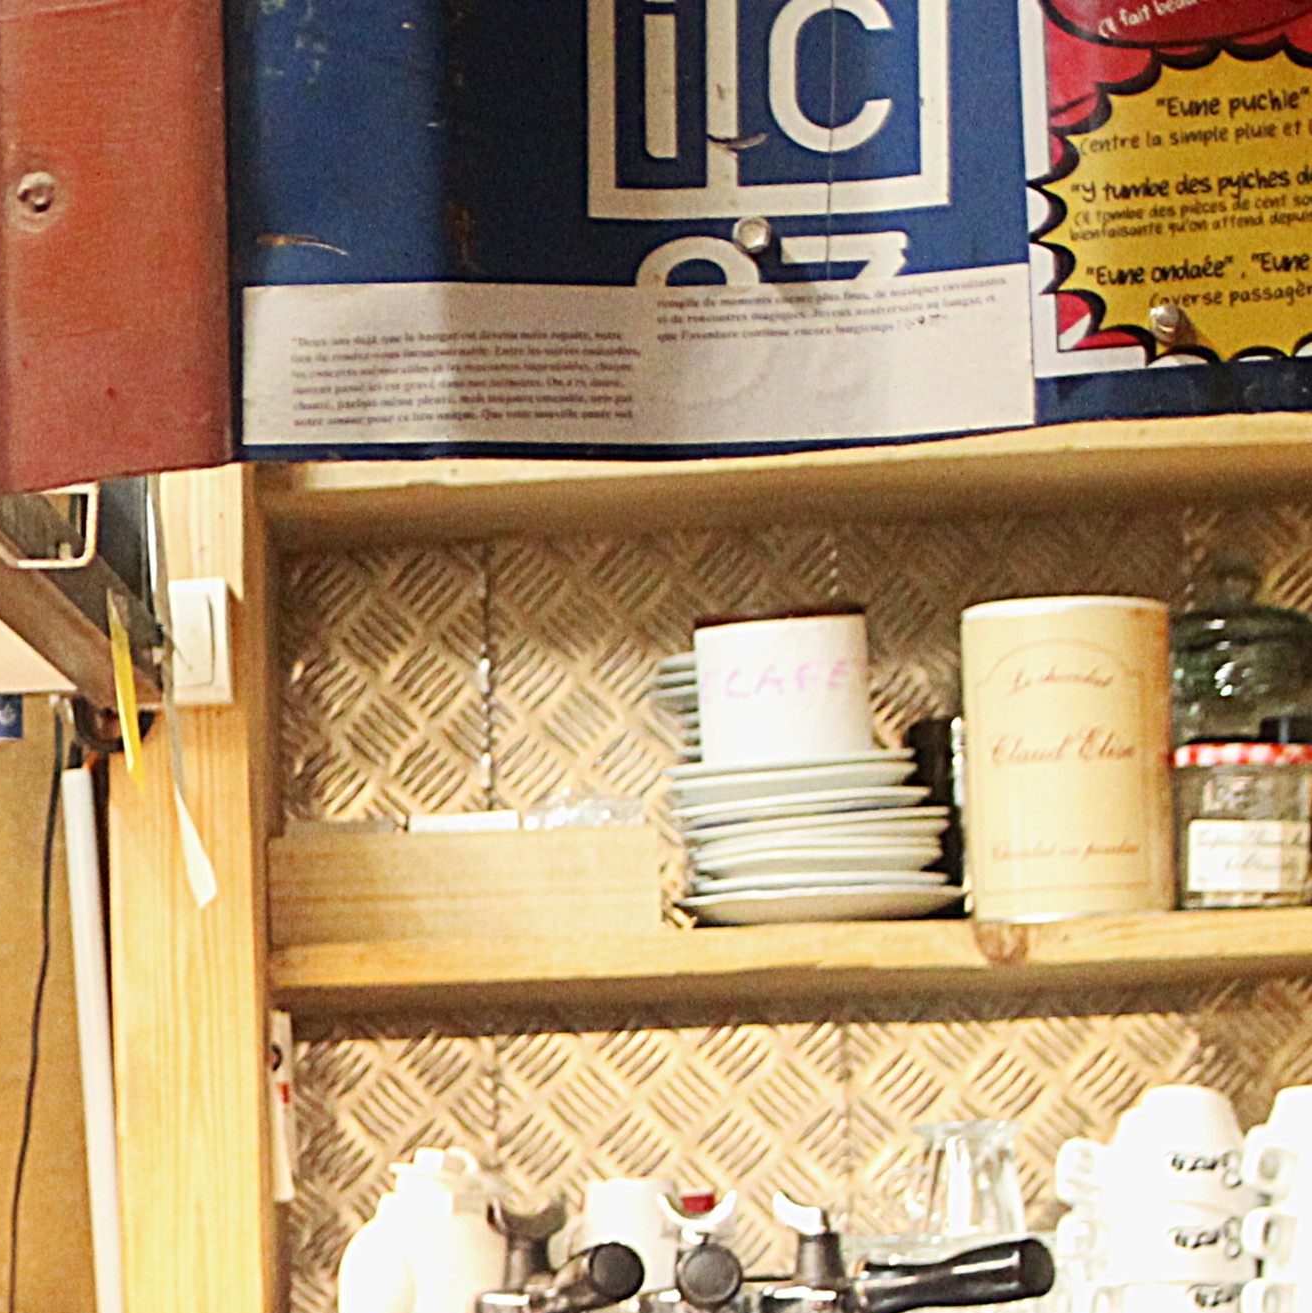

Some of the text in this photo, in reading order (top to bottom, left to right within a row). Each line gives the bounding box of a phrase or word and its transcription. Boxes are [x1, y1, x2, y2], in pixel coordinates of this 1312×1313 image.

[1169, 125, 1228, 147] simple
[1235, 121, 1277, 144] pluie
[1282, 120, 1302, 137] et
[1176, 174, 1212, 195] des
[1149, 204, 1176, 218] des
[1233, 197, 1250, 211] de
